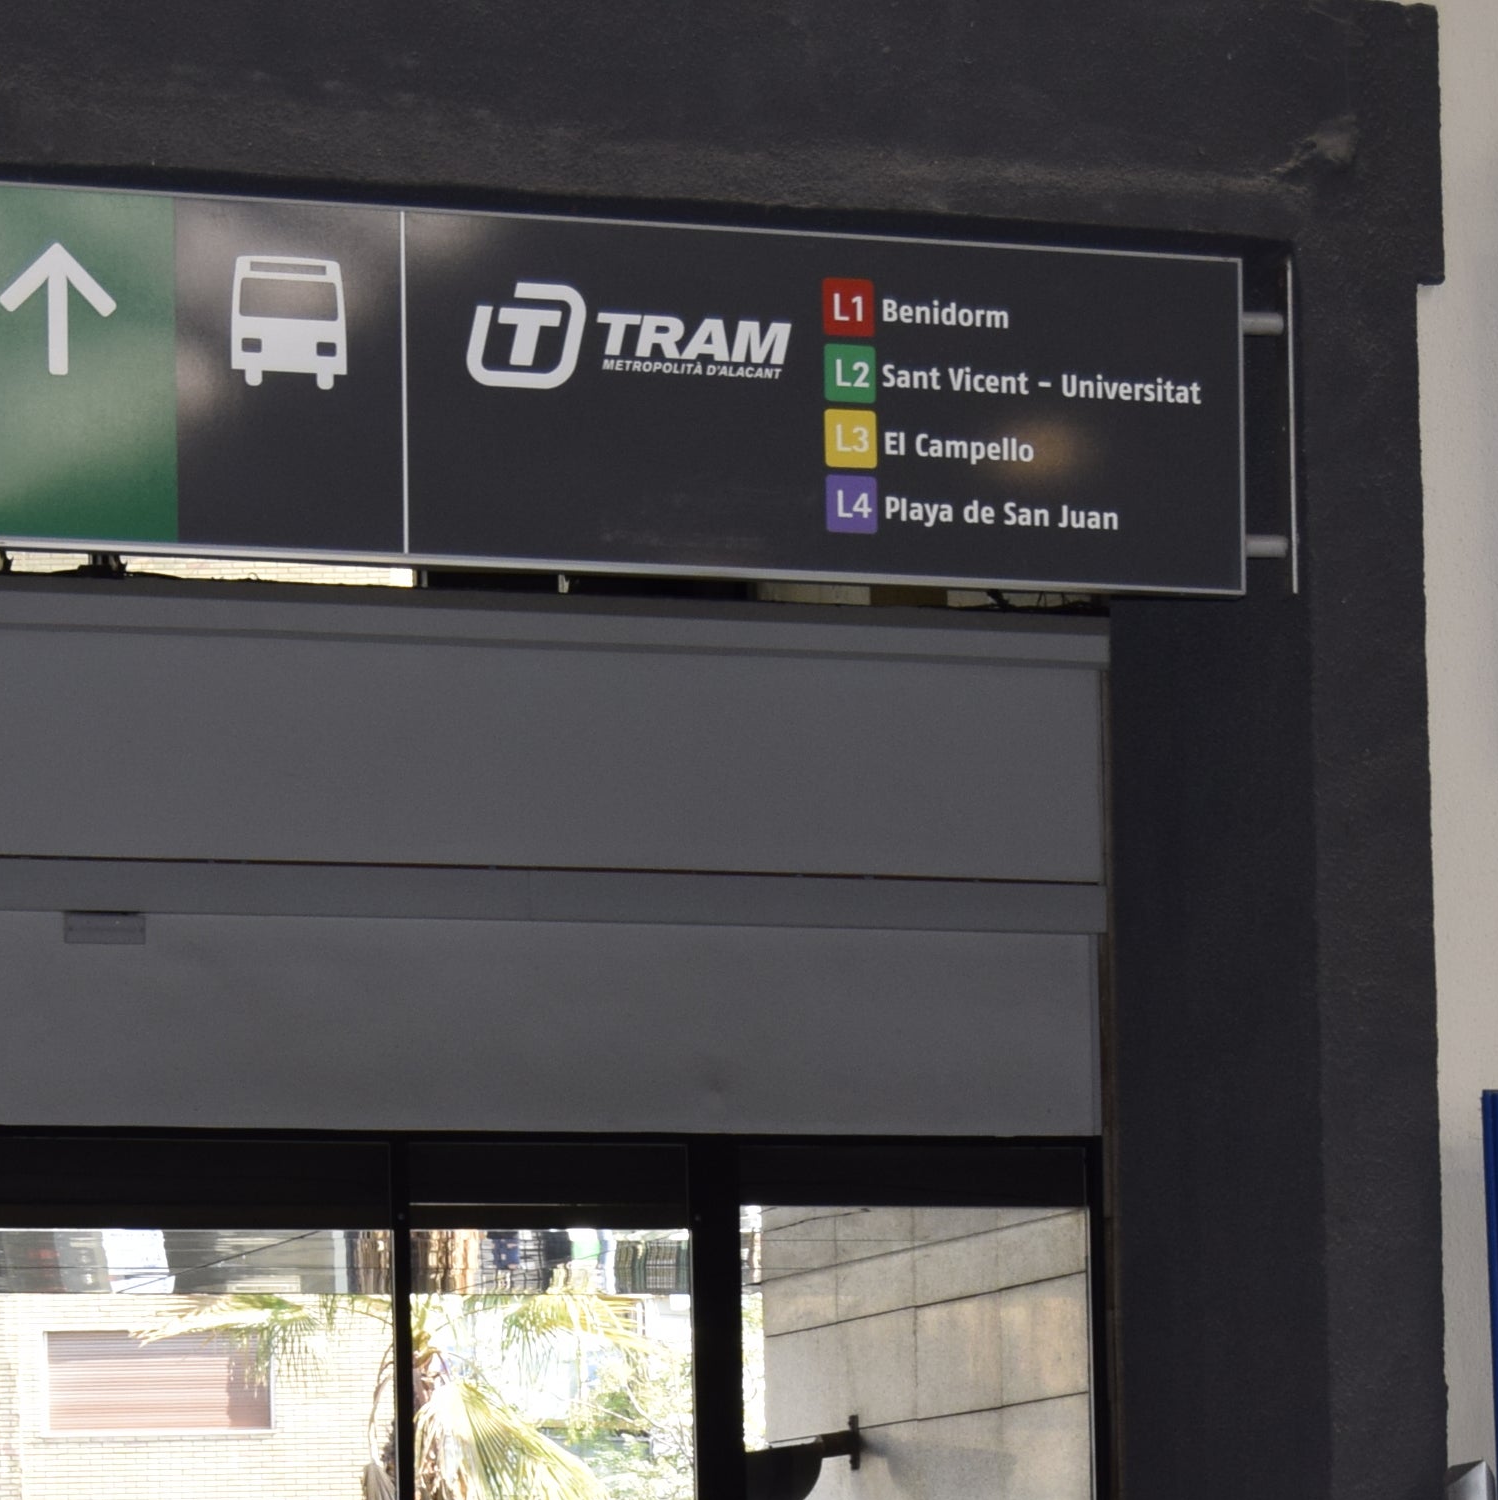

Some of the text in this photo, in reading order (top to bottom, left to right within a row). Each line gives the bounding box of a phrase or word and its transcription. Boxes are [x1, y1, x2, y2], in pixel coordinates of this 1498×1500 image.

[833, 293, 1010, 330] L1 Benidorm
[596, 312, 792, 365] TRAM
[602, 358, 782, 380] METROPOLITÀ D'ALACANT
[835, 360, 870, 388] L2
[881, 363, 941, 392] Sant
[948, 366, 1029, 396] Vicent
[1061, 373, 1202, 405] Universitat
[836, 425, 1034, 464] L3 El Campello
[837, 490, 1118, 532] L4 Playa de San Juan
